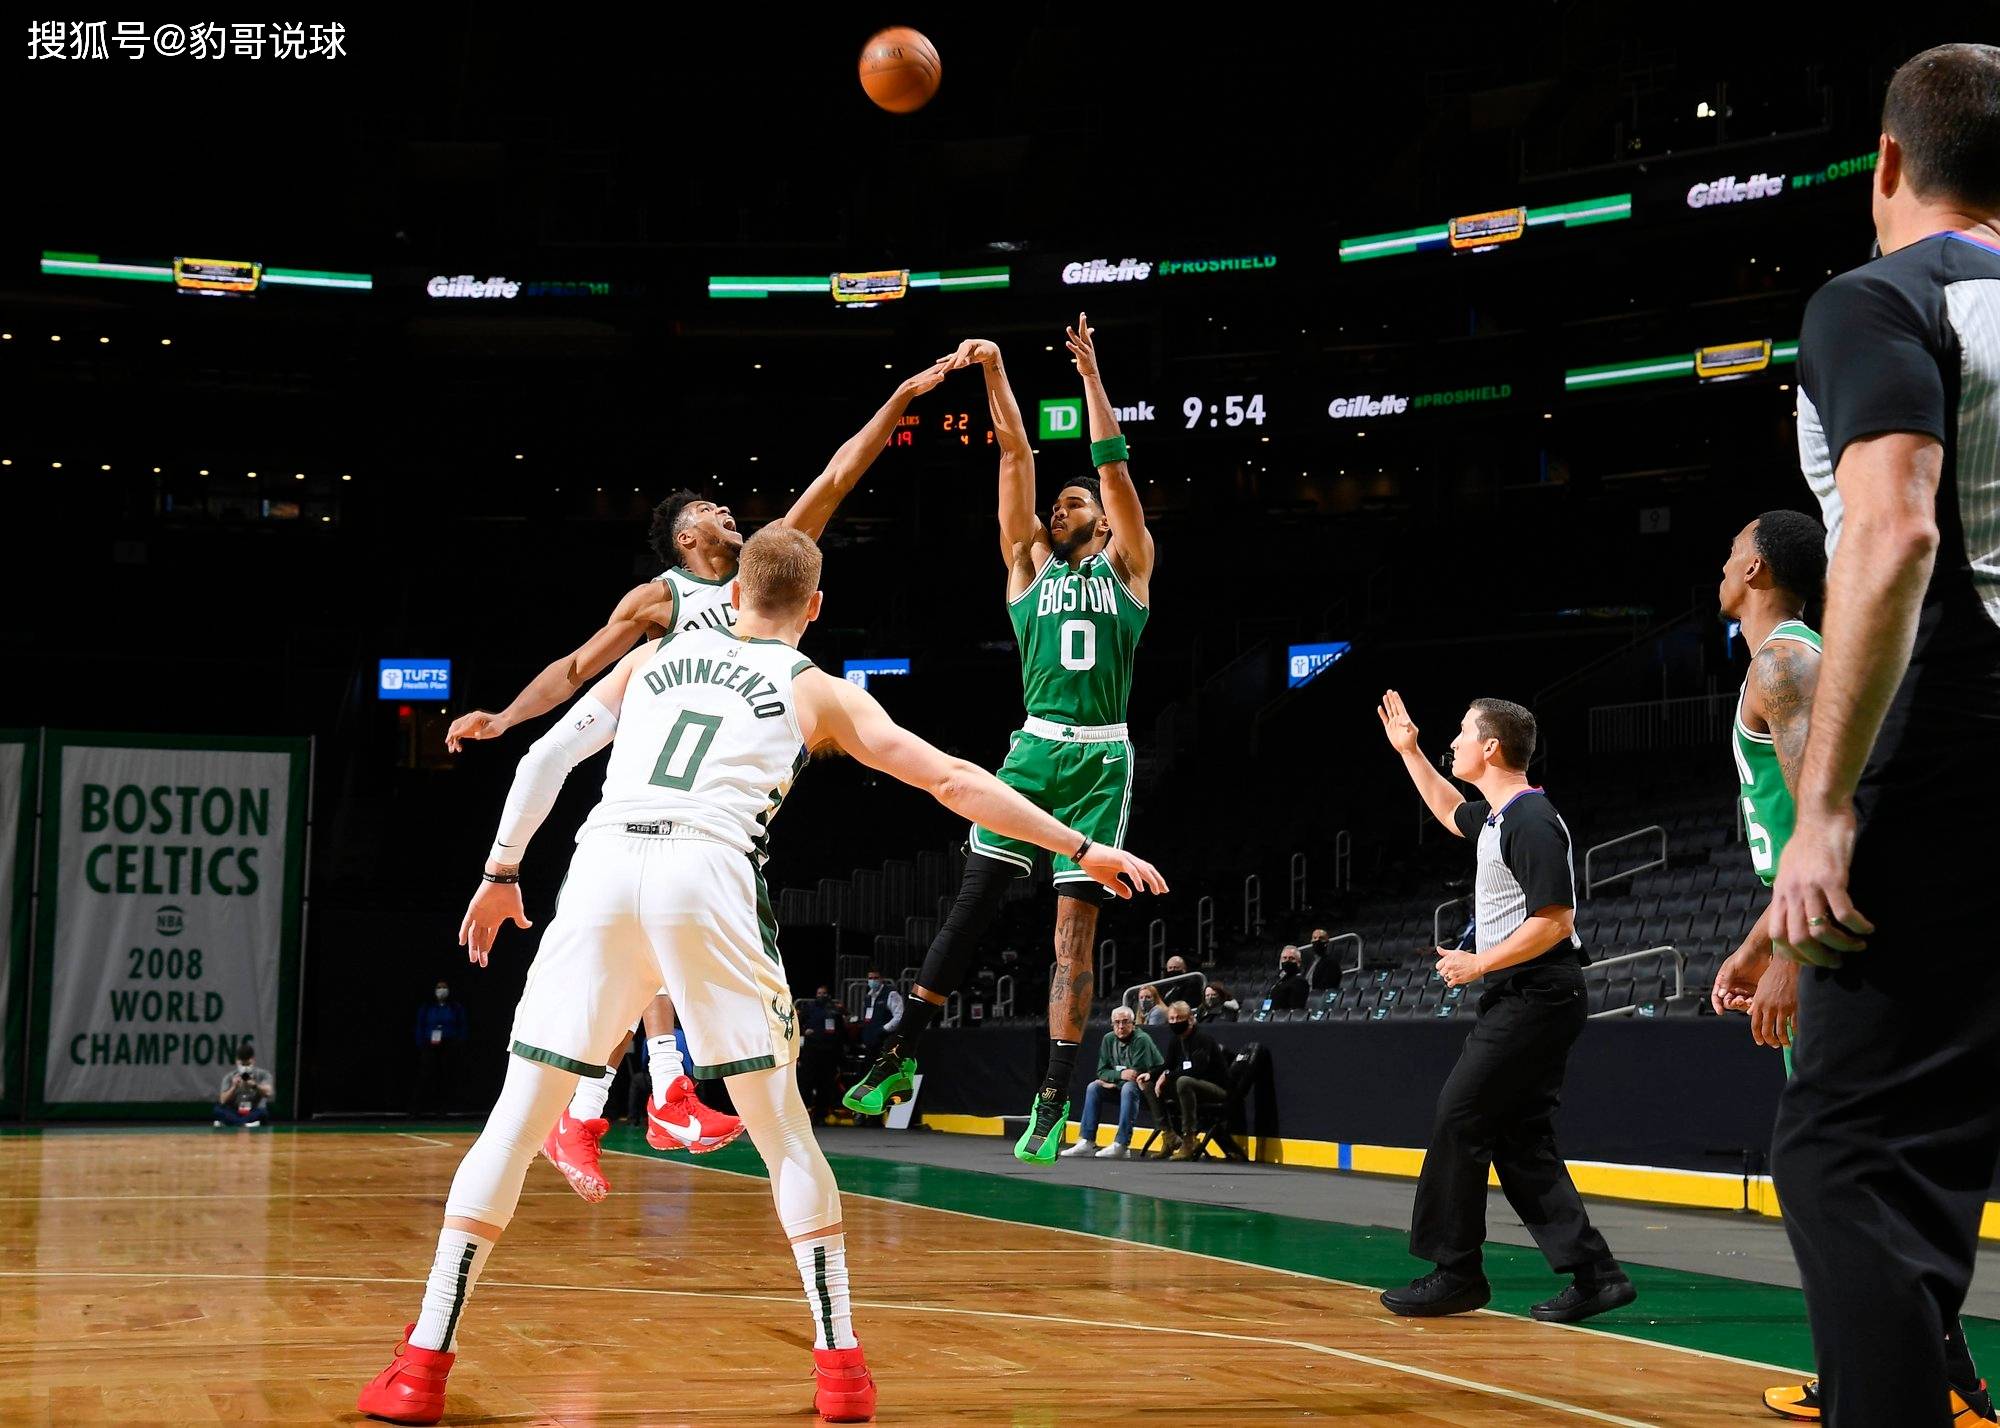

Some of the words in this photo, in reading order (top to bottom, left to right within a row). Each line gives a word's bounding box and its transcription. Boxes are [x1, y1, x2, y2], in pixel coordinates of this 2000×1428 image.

[1687, 173, 1786, 208] Gillette
[427, 275, 522, 299] Gillette
[1062, 258, 1153, 284] Gillette
[1043, 405, 1078, 431] TD
[1112, 401, 1155, 421] ank
[1183, 394, 1266, 429] 9:54
[1328, 394, 1409, 419] Gillette
[1414, 384, 1512, 409] #PROSHIELD
[943, 413, 969, 430] 2.2
[1037, 574, 1118, 617] BOSTON
[1060, 619, 1096, 671] 0
[403, 669, 448, 681] TUFTS
[643, 658, 786, 720] DIVINCENZO
[648, 709, 724, 792] 0
[81, 783, 269, 836] BOSTON
[85, 844, 260, 896] CELTICS
[156, 914, 184, 929] NBA
[128, 948, 203, 980] 2008
[110, 990, 224, 1023] WORLD
